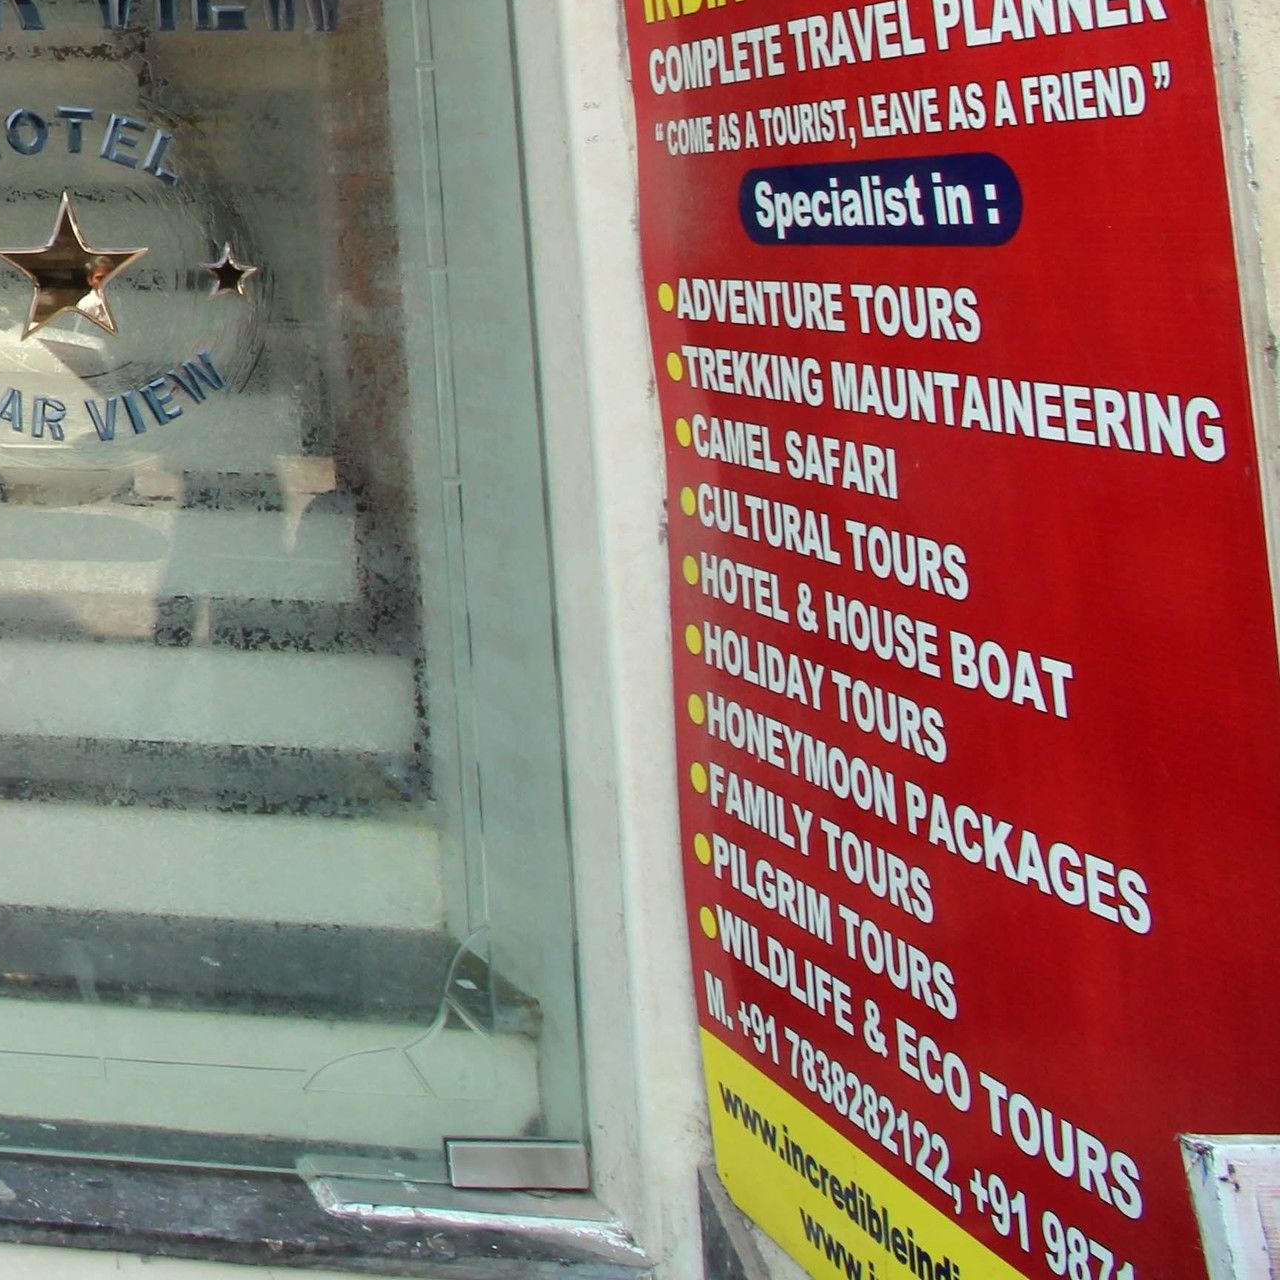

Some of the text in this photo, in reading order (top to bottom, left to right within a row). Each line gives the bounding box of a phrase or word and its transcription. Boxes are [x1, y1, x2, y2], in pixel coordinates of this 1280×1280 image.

[649, 24, 784, 94] COMPLETE
[718, 113, 740, 151] AS
[744, 110, 759, 148] A
[760, 99, 857, 149] TOURIST,
[858, 90, 938, 138] LEAVE
[947, 83, 987, 131] AS
[995, 80, 1017, 126] A
[754, 173, 923, 239] Specialist
[932, 172, 971, 225] in
[676, 277, 982, 343] ADVENTURE TOURS
[85, 352, 226, 441] VIEW
[682, 344, 1226, 463] TREKKING MAUNTAINEERING
[692, 414, 898, 500] CAMEL SAFARI
[697, 483, 969, 601] CULTURAL TOURS
[700, 552, 1073, 719] HOTEL & HOUSE BOAT
[703, 621, 948, 764] HOLIDAY TOURS
[706, 691, 1152, 935] HONEYMOON PACKAGES
[709, 762, 935, 924] FAMILY TOURS
[712, 832, 957, 1021] PILGRIM TOURS
[704, 970, 733, 1033] M.
[738, 996, 782, 1066] +91
[784, 1025, 962, 1215] 7838282122,
[969, 1167, 1031, 1253] +91
[716, 903, 1143, 1220] WILDLIFE & ECO TOURS
